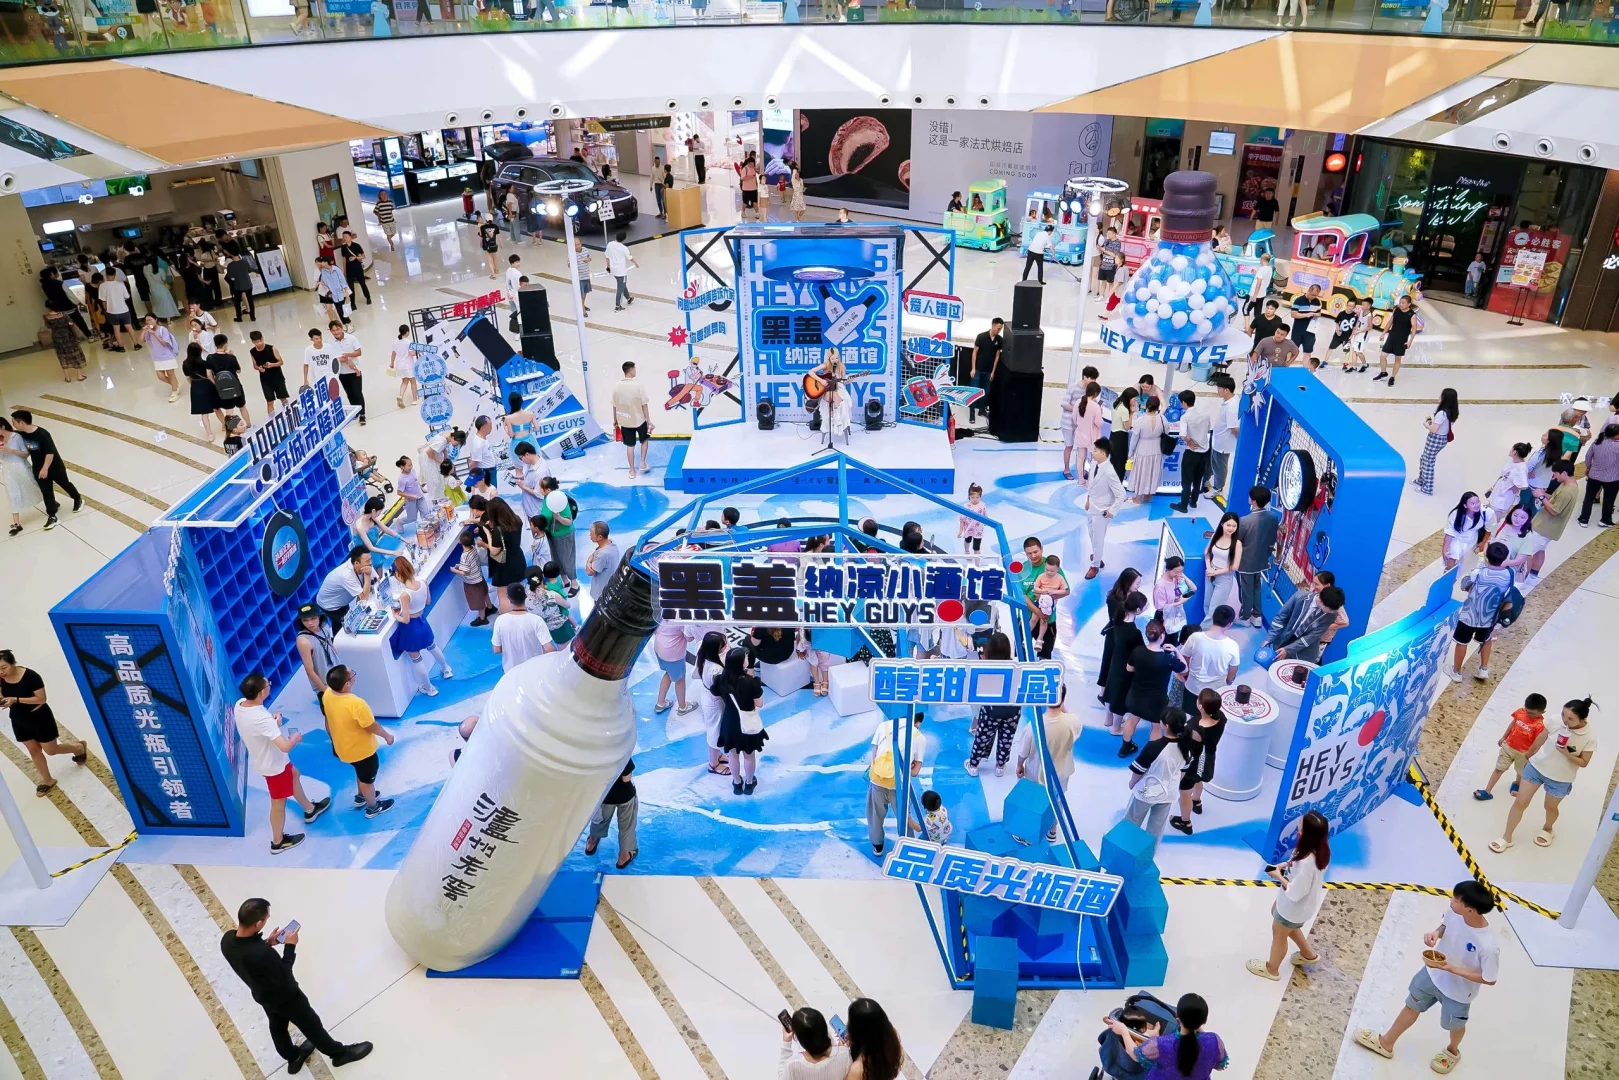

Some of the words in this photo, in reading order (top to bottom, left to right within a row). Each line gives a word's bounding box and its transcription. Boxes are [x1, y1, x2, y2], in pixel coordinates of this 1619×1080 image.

[928, 133, 1024, 155] 这是一家法式烘焙店
[989, 168, 1015, 177] COMING
[1530, 236, 1562, 249] 必胜客
[910, 297, 961, 319] 爱人错过
[761, 315, 823, 345] 黑盖
[908, 336, 954, 357] 公路之歌
[1099, 324, 1136, 353] HEY
[1140, 341, 1229, 363] GUYS
[785, 346, 878, 365] 纳凉酒馆
[247, 375, 330, 466] 1000杯特调
[273, 396, 346, 481] 为城市降温
[535, 422, 555, 437] HEY
[557, 416, 586, 430] GUYS
[658, 561, 799, 620] 黑盖
[804, 564, 1005, 600] 纳凉小酒馆
[803, 601, 857, 623] HEY
[866, 601, 935, 624] GUYS
[874, 665, 1062, 703] 醇甜口感
[105, 633, 193, 820] 高品质光瓶引领者
[1296, 741, 1348, 780] HEY
[1291, 757, 1356, 801] GUYS
[887, 844, 1122, 915] 品质光瓶酒
